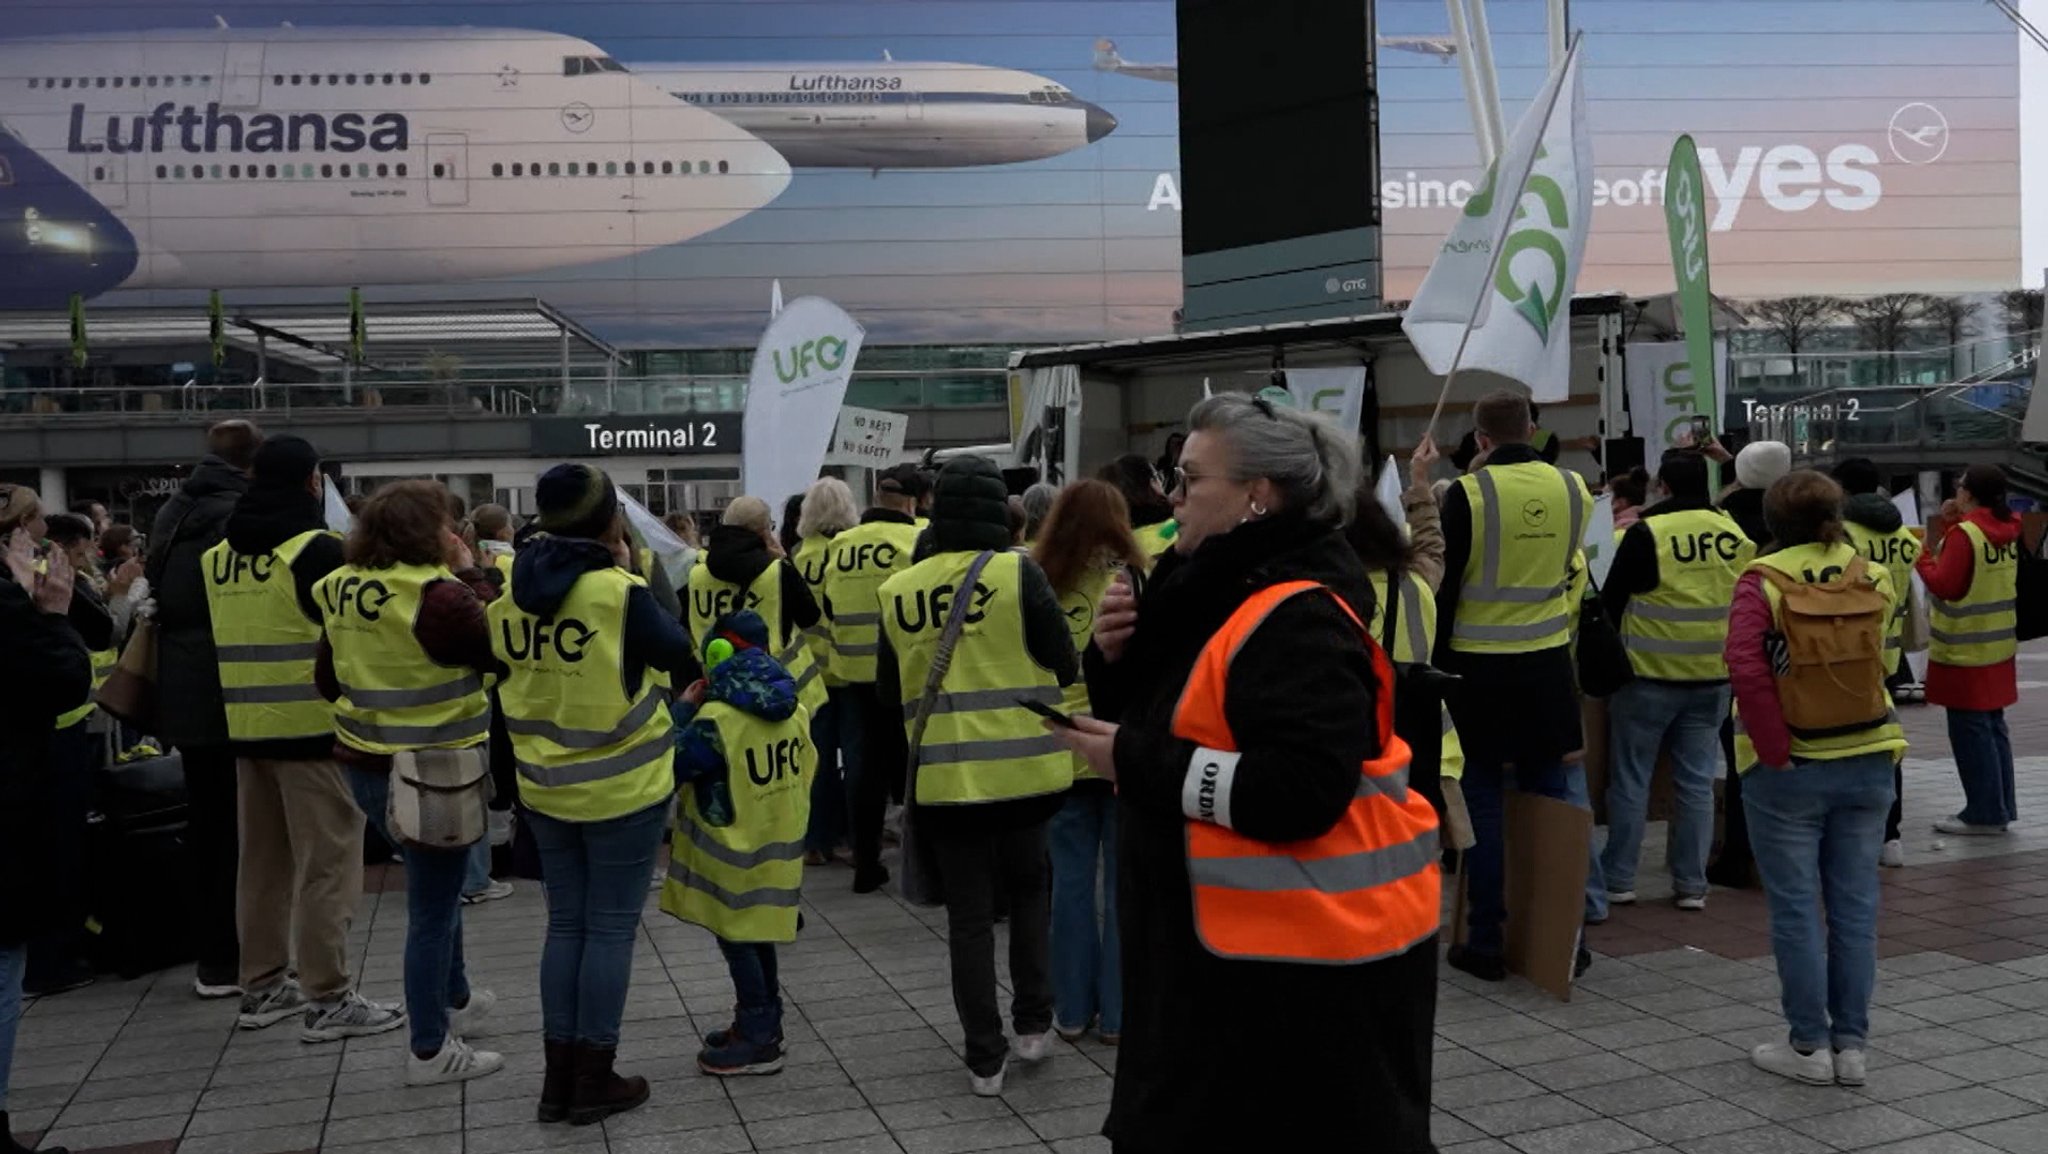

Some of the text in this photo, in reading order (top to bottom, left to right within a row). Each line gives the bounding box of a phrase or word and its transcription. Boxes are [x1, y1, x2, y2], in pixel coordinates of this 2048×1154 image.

[790, 75, 902, 90] Lufthansa
[67, 102, 409, 154] Lufthansa
[1382, 172, 1475, 208] sinc
[1697, 144, 1882, 232] yes
[1342, 278, 1367, 292] GTG
[1847, 398, 1860, 421] 2
[584, 421, 717, 449] Terminal 2
